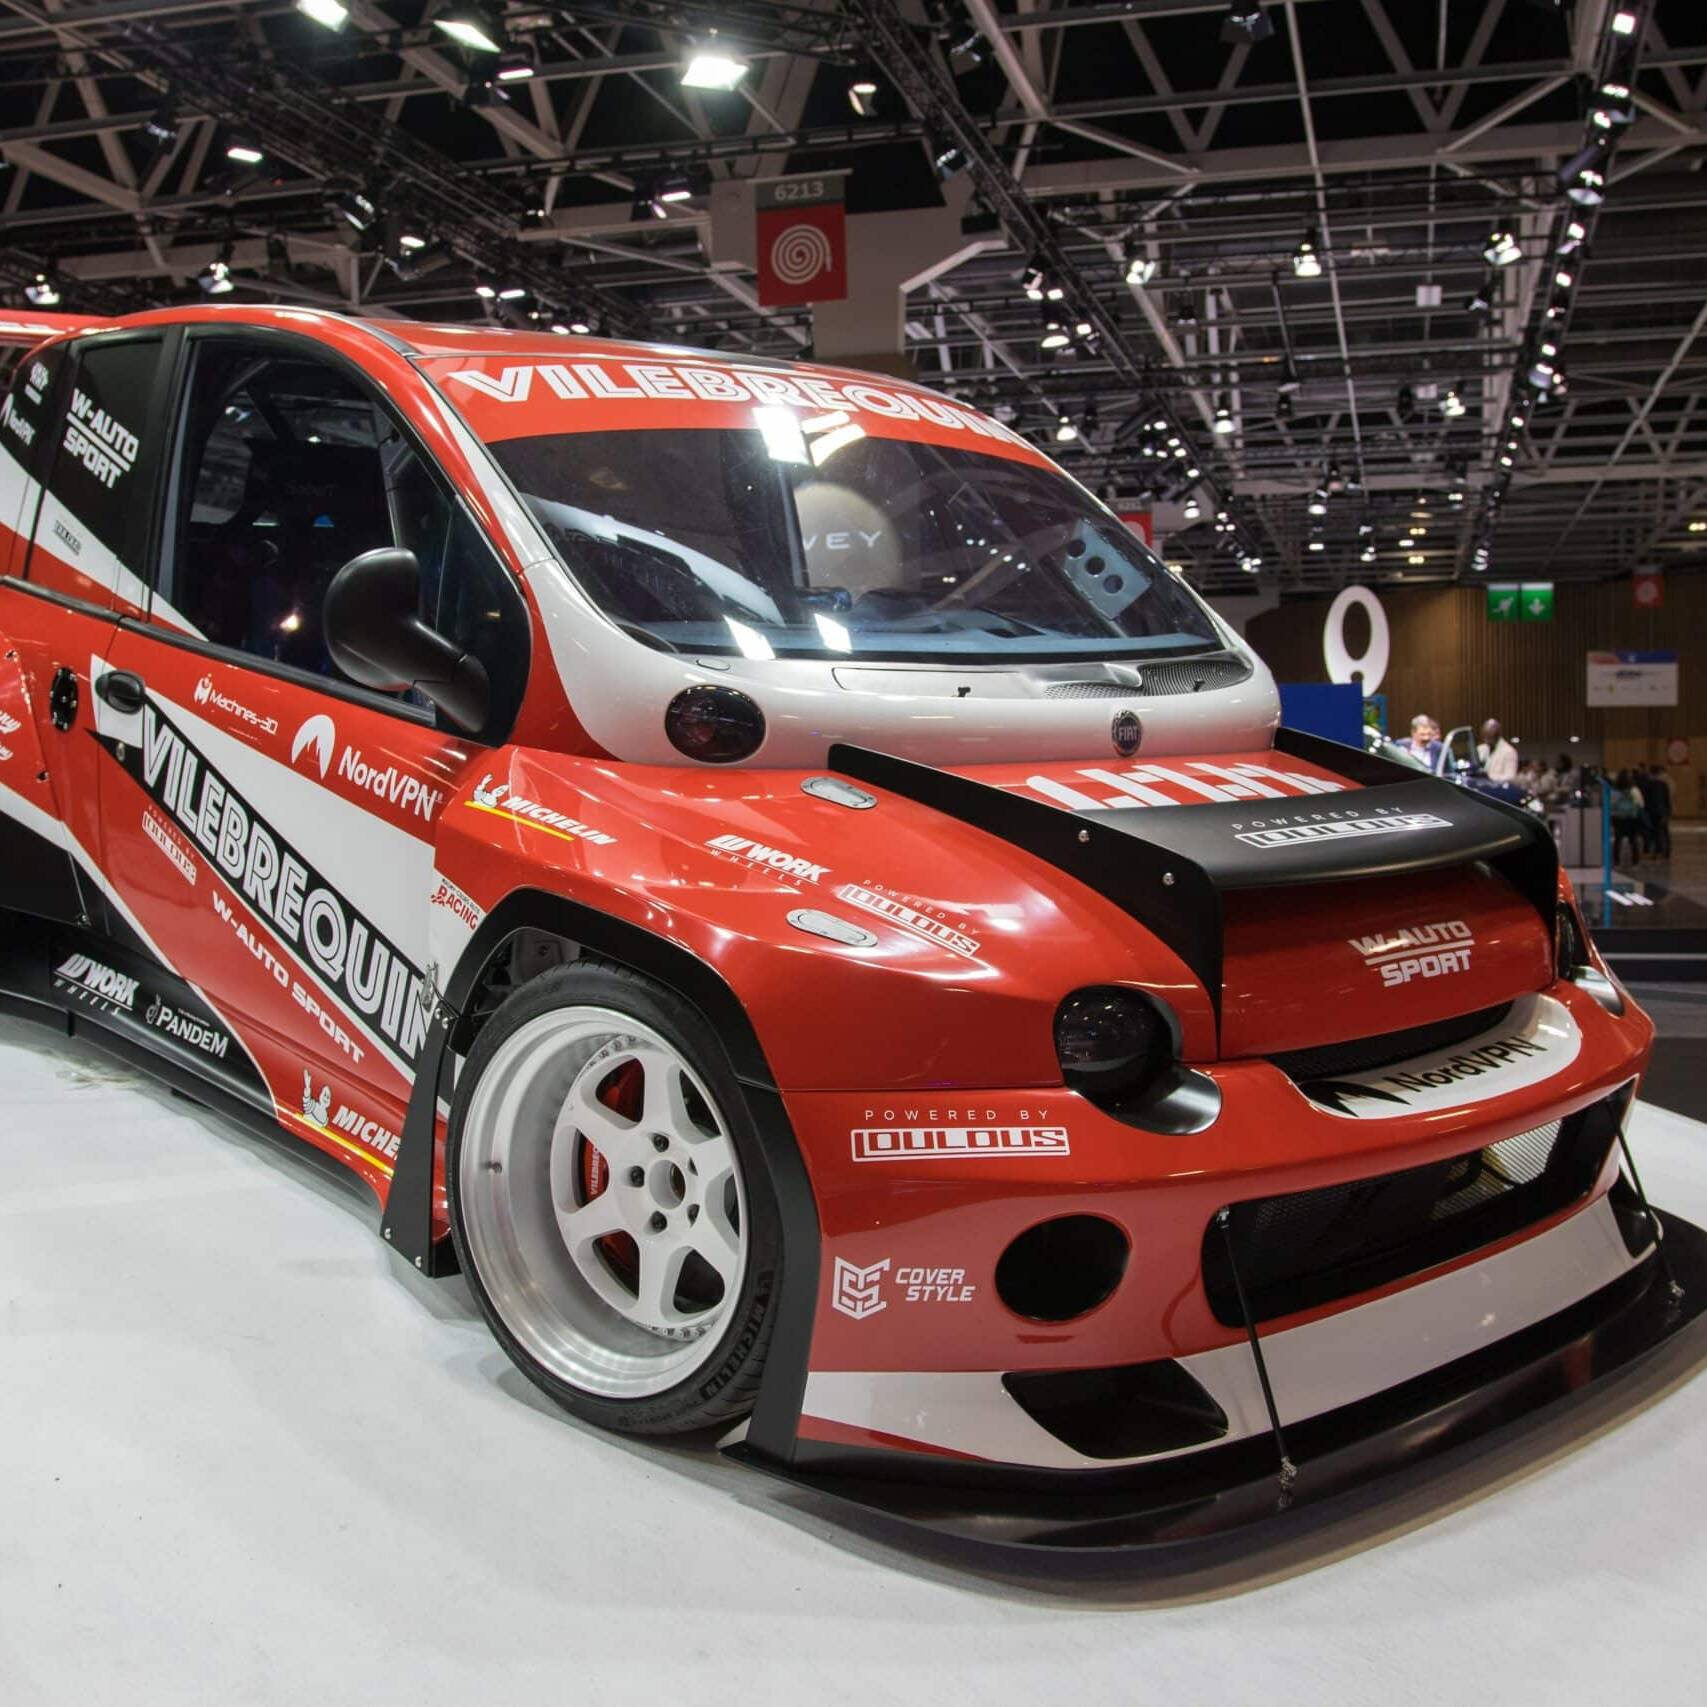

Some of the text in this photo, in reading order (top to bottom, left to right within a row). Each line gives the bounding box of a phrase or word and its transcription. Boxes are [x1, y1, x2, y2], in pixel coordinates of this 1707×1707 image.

[774, 181, 824, 201] 6213
[71, 388, 139, 463] W-AUTO
[63, 426, 121, 488] SPORT
[1118, 725, 1138, 742] FIAT
[501, 796, 618, 845] MICHELIN
[1232, 806, 1404, 832] POWERED BY
[746, 843, 833, 883] WORK
[431, 884, 479, 930] RACING
[863, 879, 981, 935] POWERED BY
[1347, 920, 1473, 957] W-AUTO
[84, 961, 140, 1007] WORK
[213, 890, 365, 1063] W-AUTO SPORT
[1380, 949, 1472, 987] SPORT
[156, 1006, 229, 1058] PANDEM
[1383, 1035, 1548, 1093] NordVPN
[332, 1104, 401, 1161] MICHE
[865, 1110, 1048, 1120] POWERED BY
[896, 1268, 965, 1285] COVER
[905, 1286, 976, 1302] STYLE
